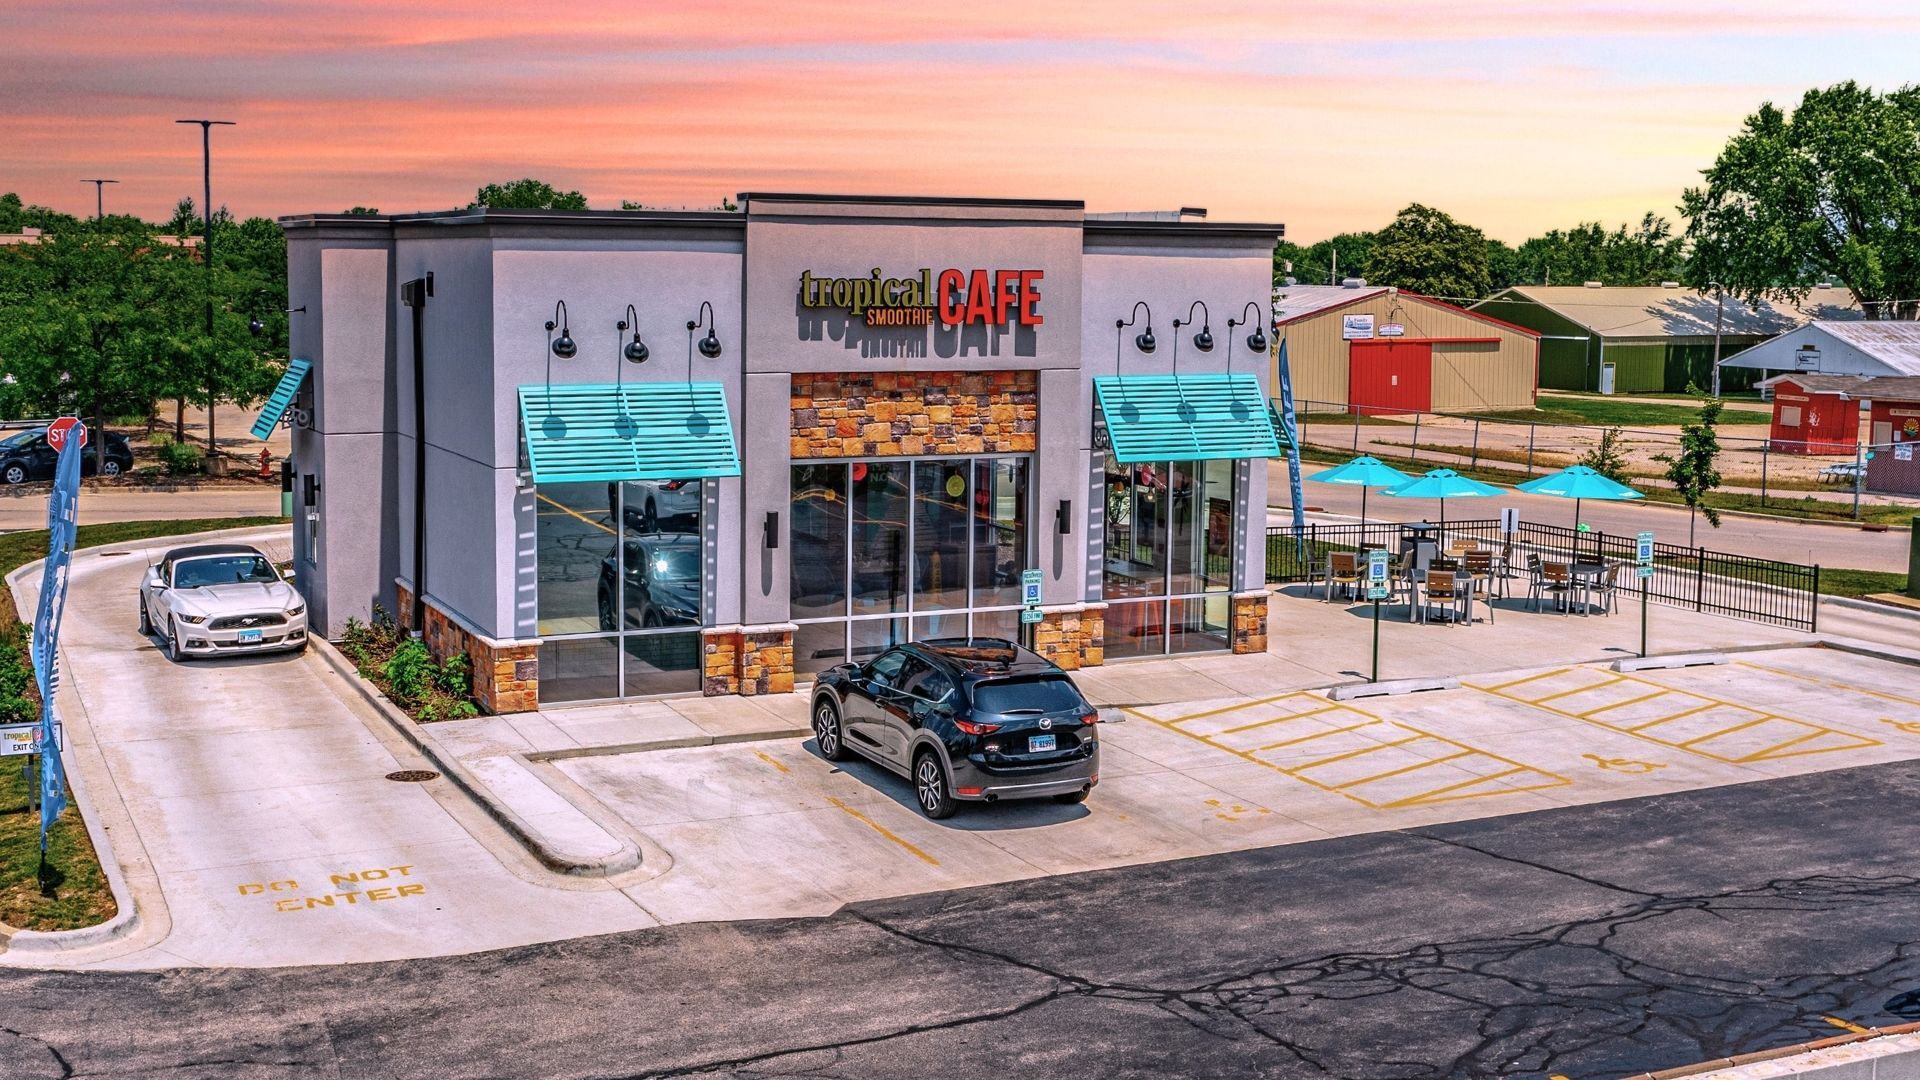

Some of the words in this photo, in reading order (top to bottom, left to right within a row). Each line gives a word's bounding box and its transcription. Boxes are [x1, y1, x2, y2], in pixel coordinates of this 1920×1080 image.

[800, 268, 933, 315] tropical
[938, 269, 1044, 325] CAFE
[867, 309, 933, 326] SMOOTHIE
[4, 730, 31, 740] tropical
[238, 880, 299, 896] DO
[330, 865, 414, 885] NOT
[276, 883, 426, 912] ENTER
